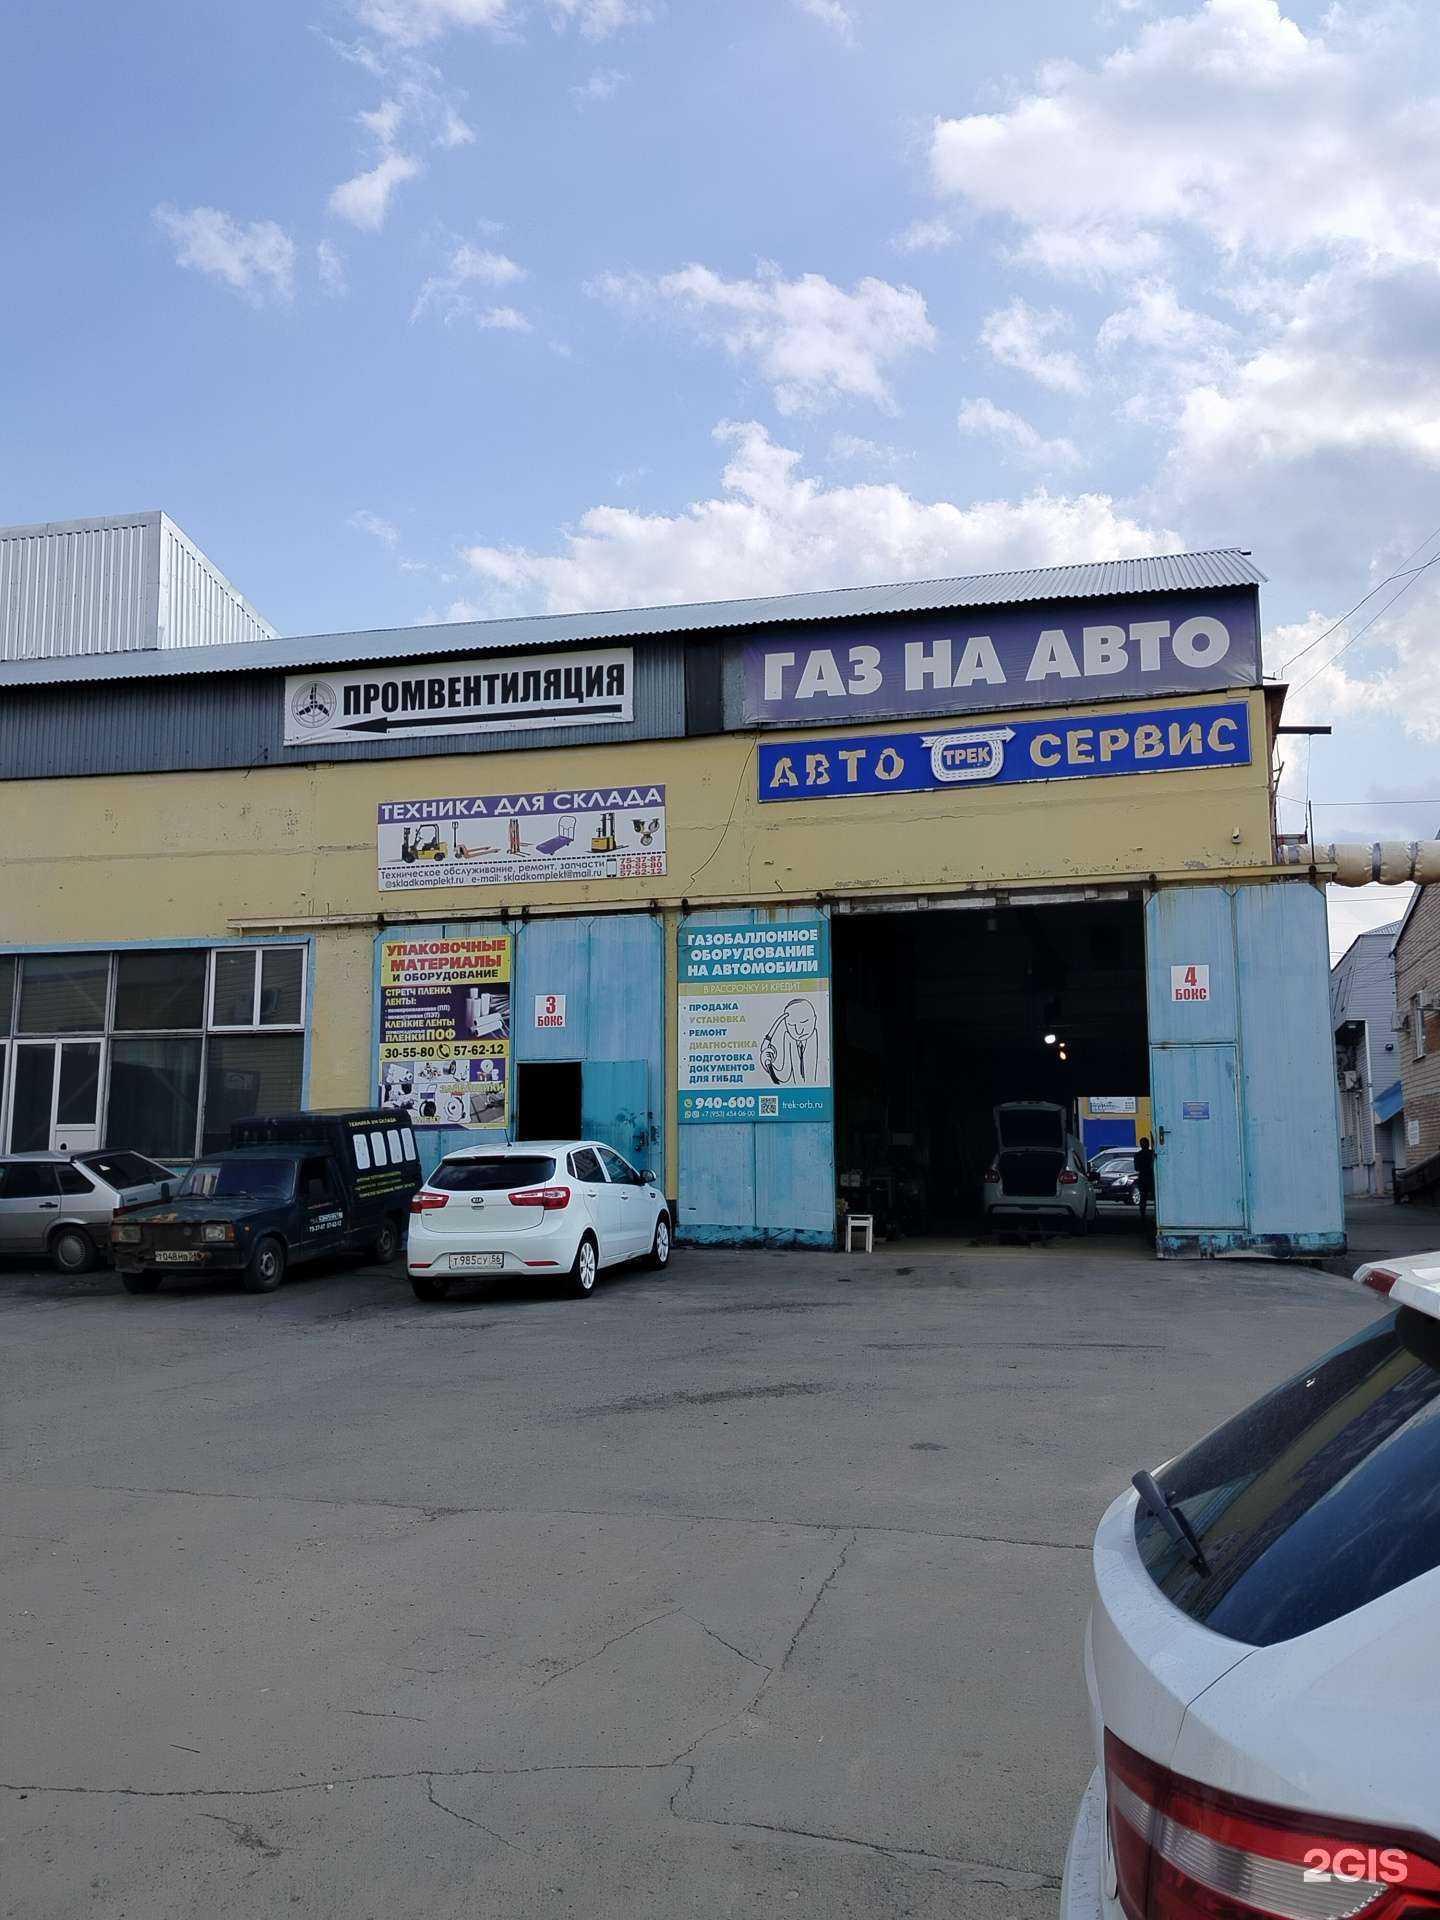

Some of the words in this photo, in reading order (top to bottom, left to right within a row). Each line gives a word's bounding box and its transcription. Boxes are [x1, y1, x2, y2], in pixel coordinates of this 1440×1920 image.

[764, 645, 883, 701] ГАЗ
[904, 635, 1007, 691] НА
[1025, 615, 1230, 682] АВТО
[343, 663, 625, 716] ПРОМВЕНТИЛЯЦИЯ
[769, 747, 905, 788] АВТО
[943, 746, 991, 766] ТРЕК
[1029, 717, 1238, 767] СЕРВИС
[381, 799, 488, 820] ТЕХНИКА
[494, 795, 545, 816] ДЛЯ
[553, 787, 662, 810] СКЛАДА
[380, 868, 441, 880] Техническое
[560, 860, 605, 870] запчасти
[471, 871, 501, 883] e-mail:
[687, 929, 818, 946] ГАЗОБАЛЛОННОЕ
[386, 939, 506, 956] УПАКОВОЧНЫЕ
[690, 944, 815, 962] ОБОРУДОВАНИЕ
[390, 955, 501, 972] МАТЕРИАЛЫ
[687, 964, 709, 977] НА
[711, 959, 818, 976] АВТОМОБИЛИ
[393, 974, 400, 982] И
[404, 969, 499, 982] ОБОРУДОВАНИЕ
[1184, 966, 1197, 986] 4
[385, 988, 416, 997] СТРЕТЧ
[418, 986, 452, 995] ПЛЕНКА
[710, 983, 760, 993] РАССРОЧКУ
[770, 981, 801, 991] КРЕДИТ
[1175, 987, 1207, 1001] БОКС
[385, 997, 417, 1006] ЛЕНТЫ:
[546, 996, 556, 1014] 3
[688, 1003, 739, 1012] ПРОДАЖА
[385, 1019, 425, 1029] КЛЕЙКИЕ
[426, 1018, 455, 1027] ЛЕНТЫ
[537, 1015, 563, 1027] БОКС
[689, 1015, 746, 1024] УСТАНОВКА
[385, 1033, 426, 1042] ПЛЕНКИ
[426, 1028, 456, 1040] ПОФ
[688, 1028, 728, 1037] РЕМОНТ
[384, 1046, 435, 1059] 30-55-80
[453, 1044, 504, 1056] 57-62-12
[688, 1040, 758, 1051] ДИАГНОСТИКА
[688, 1053, 753, 1063] ПОДГОТОВКА
[688, 1064, 755, 1074] ДОКУМЕНТОВ
[688, 1075, 709, 1085] ДЛЯ
[711, 1074, 744, 1083] ГИБДД
[695, 1096, 756, 1109] 940-600
[782, 1100, 823, 1109] trek-orb.ru
